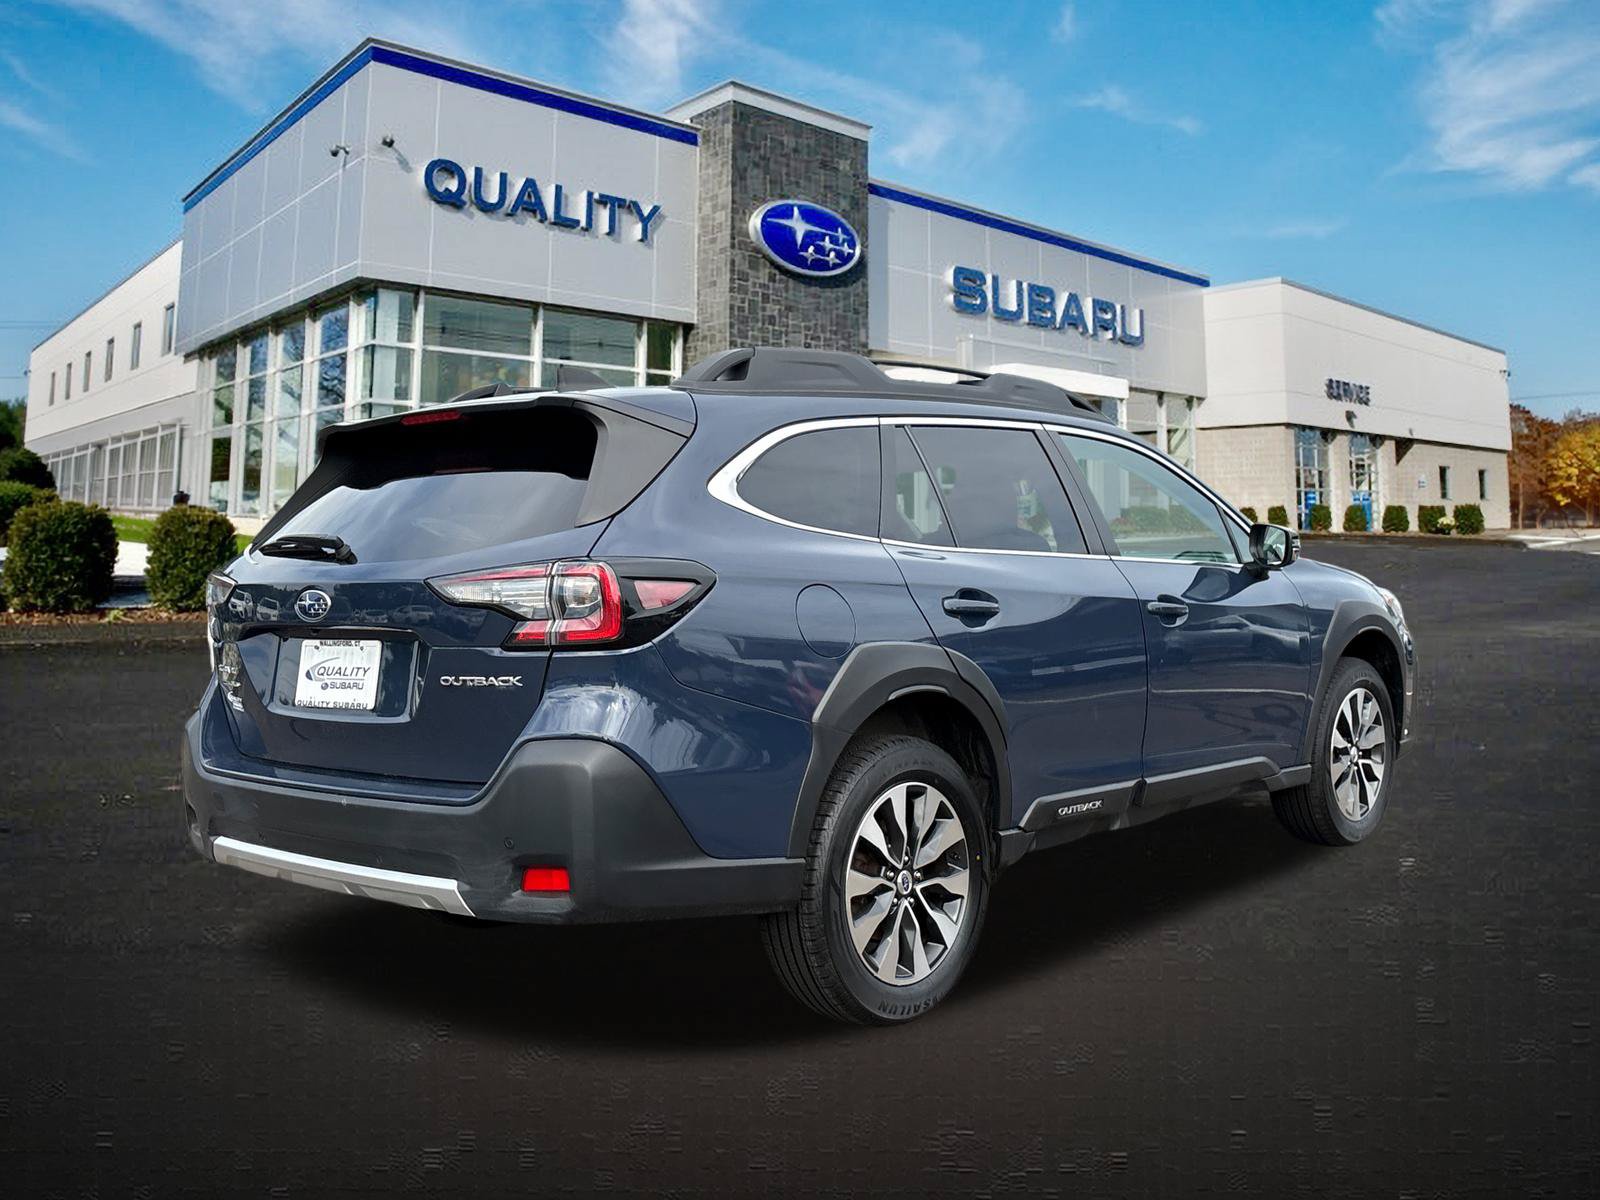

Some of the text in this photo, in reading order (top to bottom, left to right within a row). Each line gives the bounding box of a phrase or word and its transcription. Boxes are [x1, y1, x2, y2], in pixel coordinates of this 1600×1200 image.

[424, 158, 661, 242] QUALITY
[951, 265, 1144, 346] SUBARU
[1325, 378, 1370, 406] SERVICE
[316, 666, 371, 677] QUALITY
[329, 682, 364, 690] SUBARU
[440, 675, 523, 686] OUTBACK
[333, 700, 368, 709] SUBARU
[1058, 800, 1102, 815] OUTBACK
